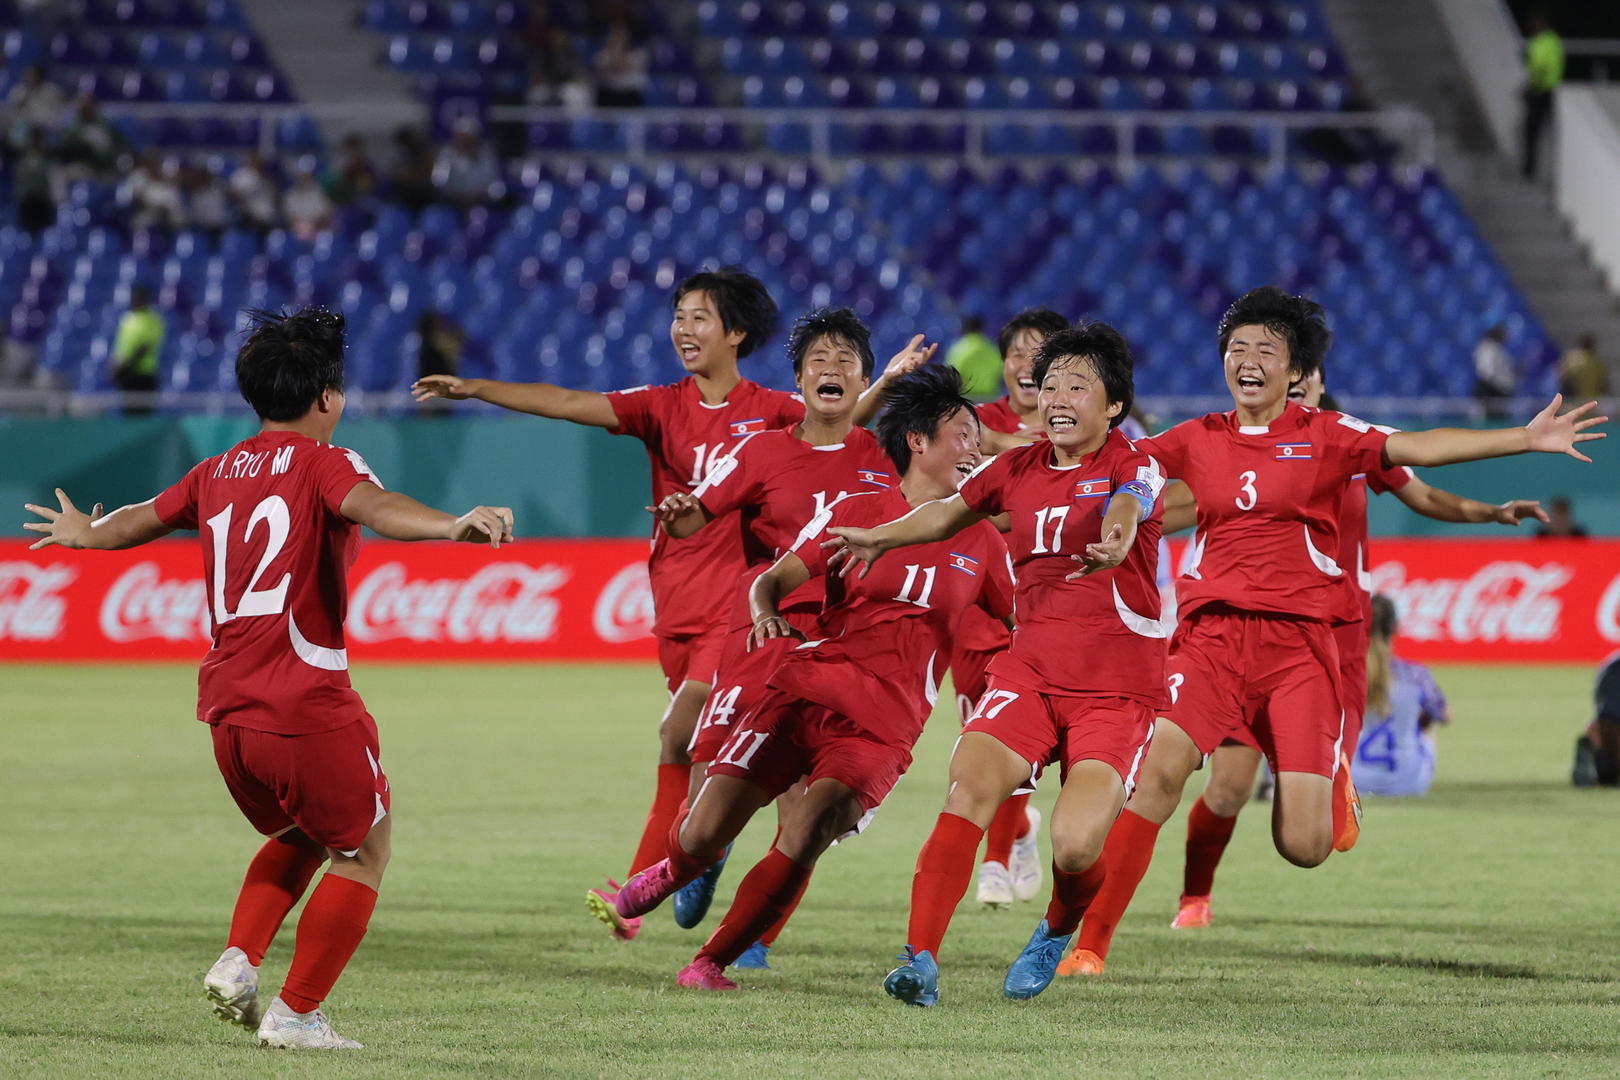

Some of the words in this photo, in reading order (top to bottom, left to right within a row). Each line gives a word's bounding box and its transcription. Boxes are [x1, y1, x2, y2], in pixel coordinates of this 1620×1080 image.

[270, 445, 296, 476] MI
[1235, 470, 1258, 512] 3
[1031, 505, 1071, 555] 17
[206, 494, 292, 625] 12
[892, 563, 938, 609] 11
[701, 685, 743, 730] 14
[966, 688, 1020, 724] 17
[718, 728, 770, 770] 11
[1358, 715, 1398, 775] 4
